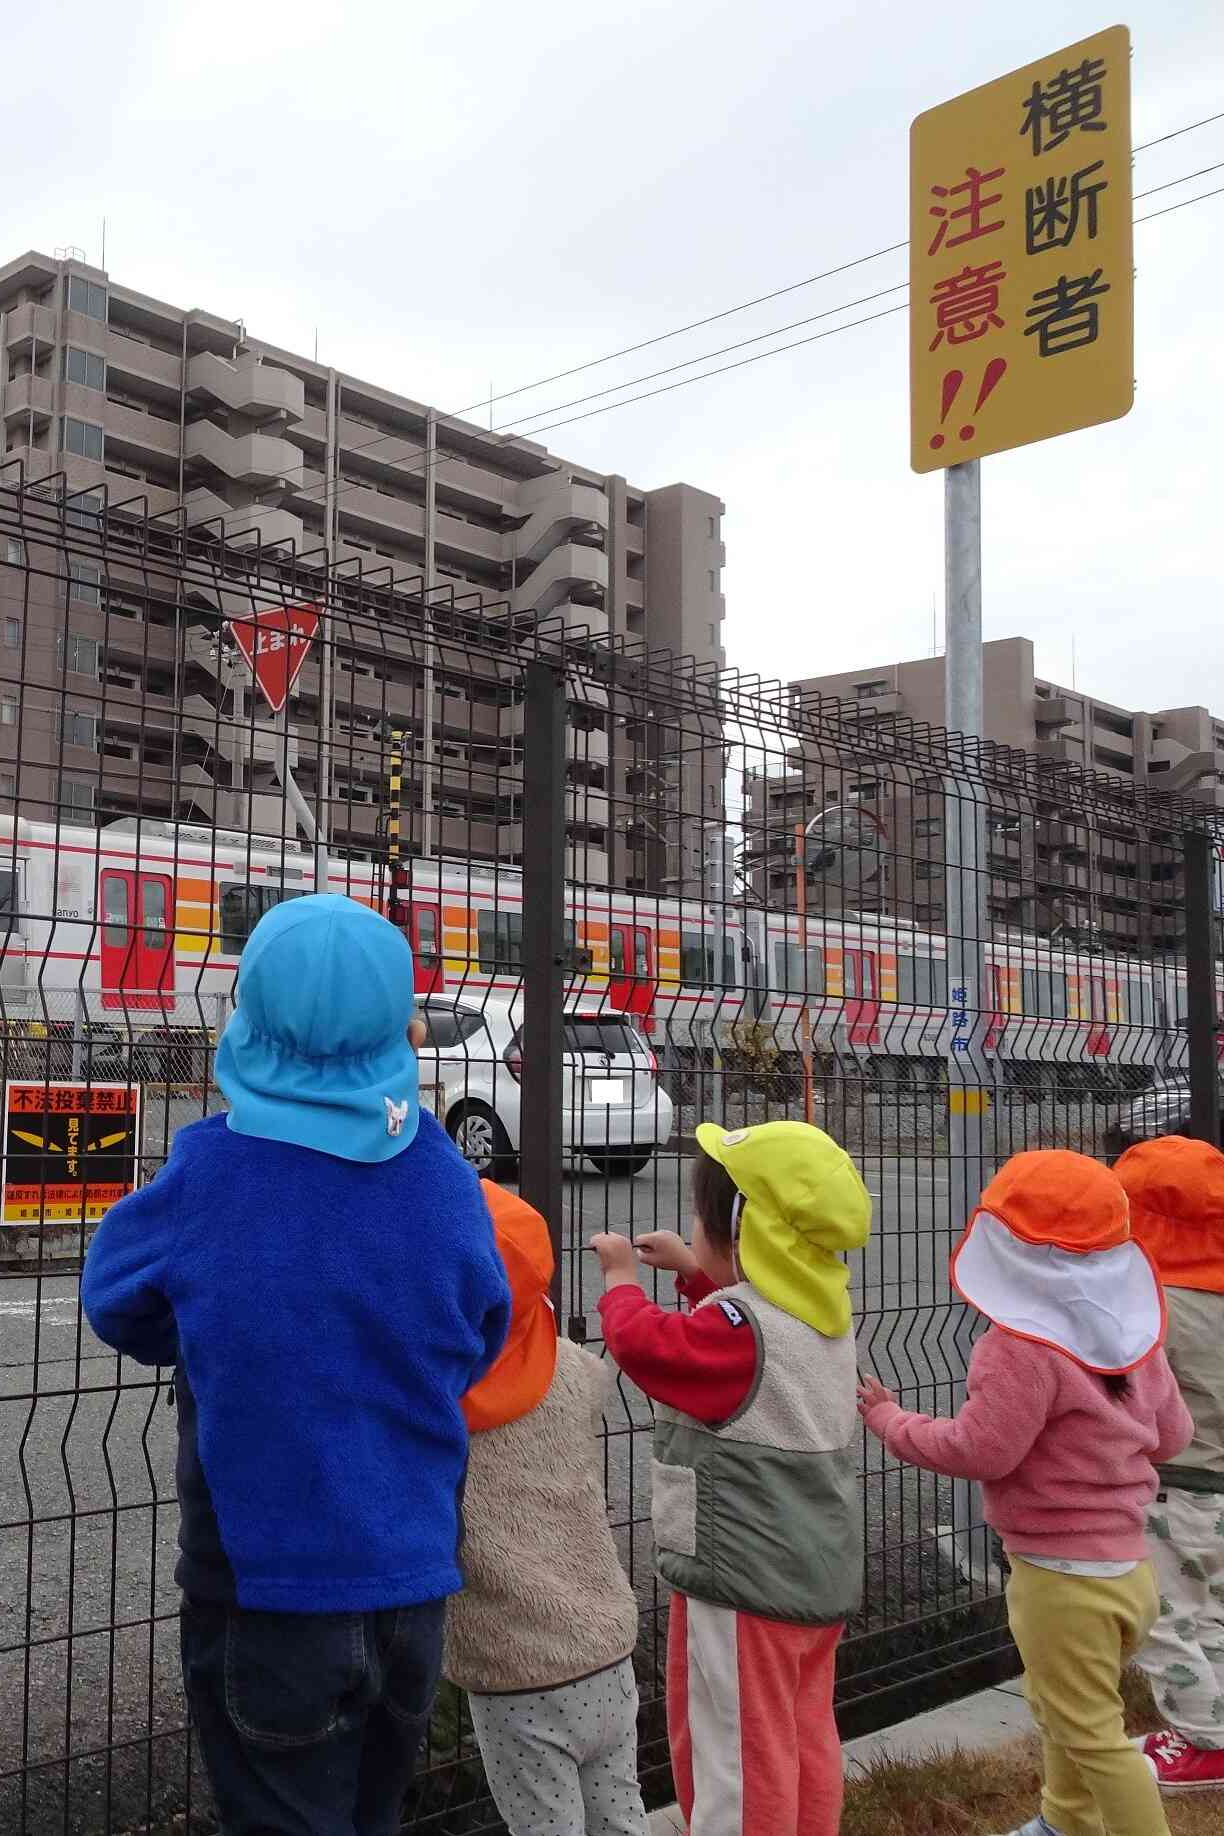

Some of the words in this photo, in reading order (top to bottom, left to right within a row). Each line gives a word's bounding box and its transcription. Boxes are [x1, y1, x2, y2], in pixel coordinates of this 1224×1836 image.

[1019, 58, 1111, 358] 横断者
[250, 623, 307, 656] 止まれ
[951, 987, 969, 1051] 姫路市
[13, 1088, 134, 1112] 不法投棄禁止
